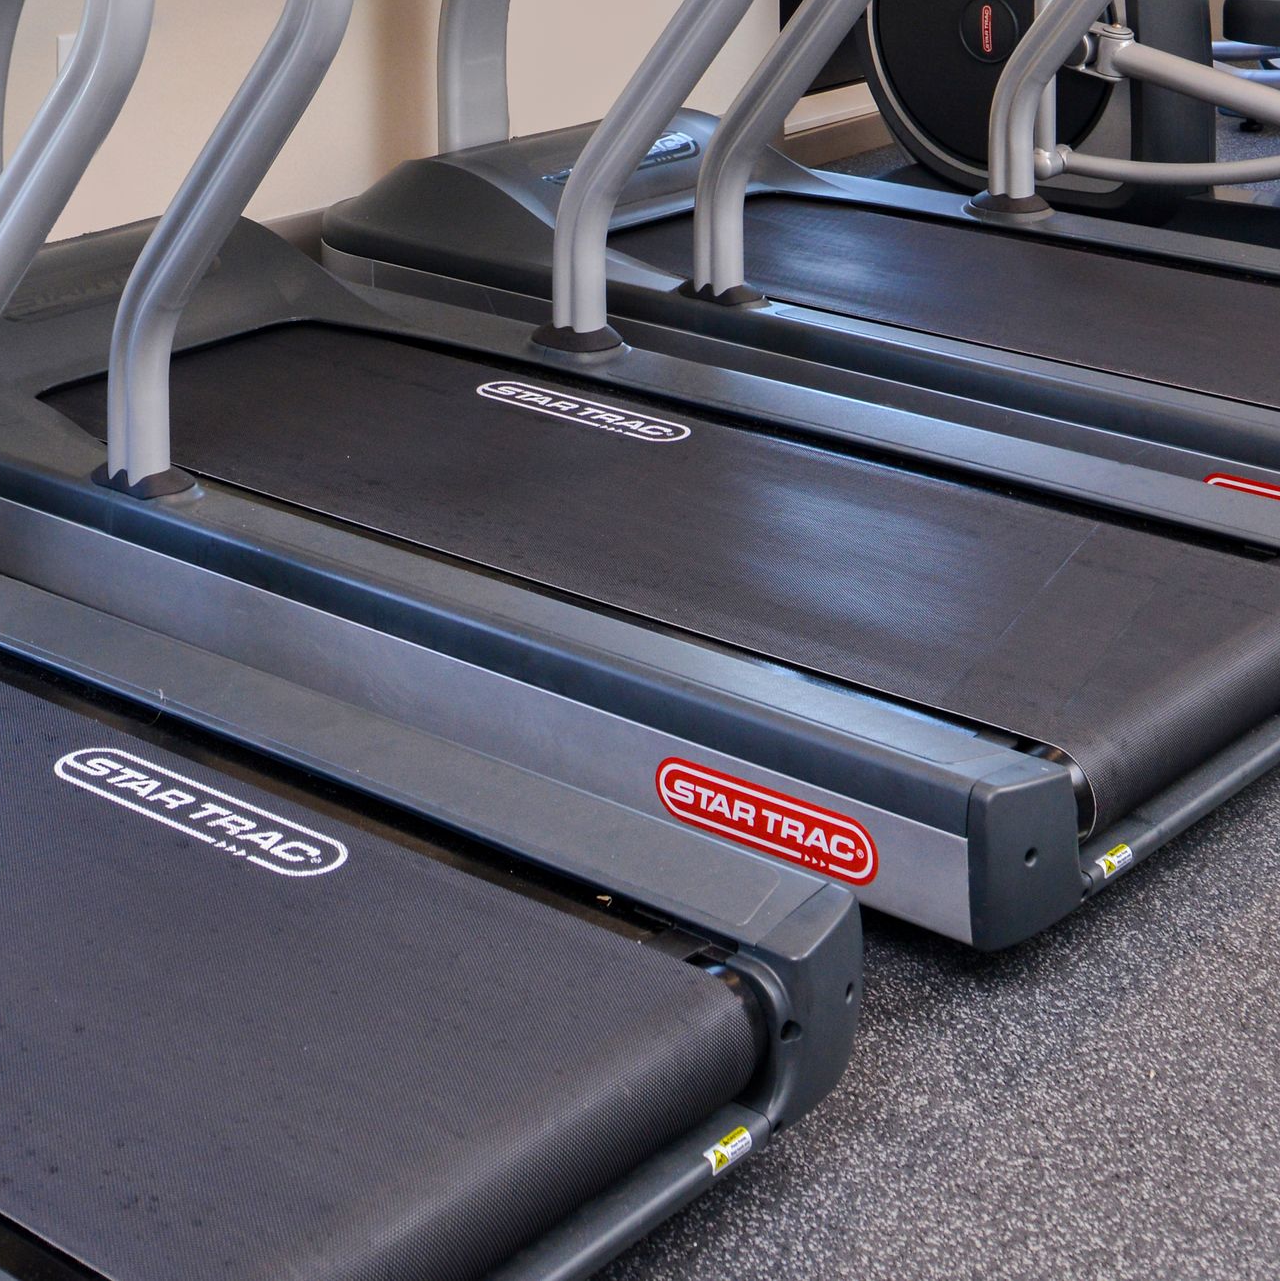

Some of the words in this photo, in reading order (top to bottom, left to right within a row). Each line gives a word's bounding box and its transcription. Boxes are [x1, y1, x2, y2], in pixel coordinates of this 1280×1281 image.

[495, 386, 579, 412] STAR
[577, 407, 673, 436] TRAC
[80, 758, 196, 810] STAR
[189, 803, 322, 863] TRAC
[670, 779, 756, 827] STAR
[761, 809, 856, 861] TRAC
